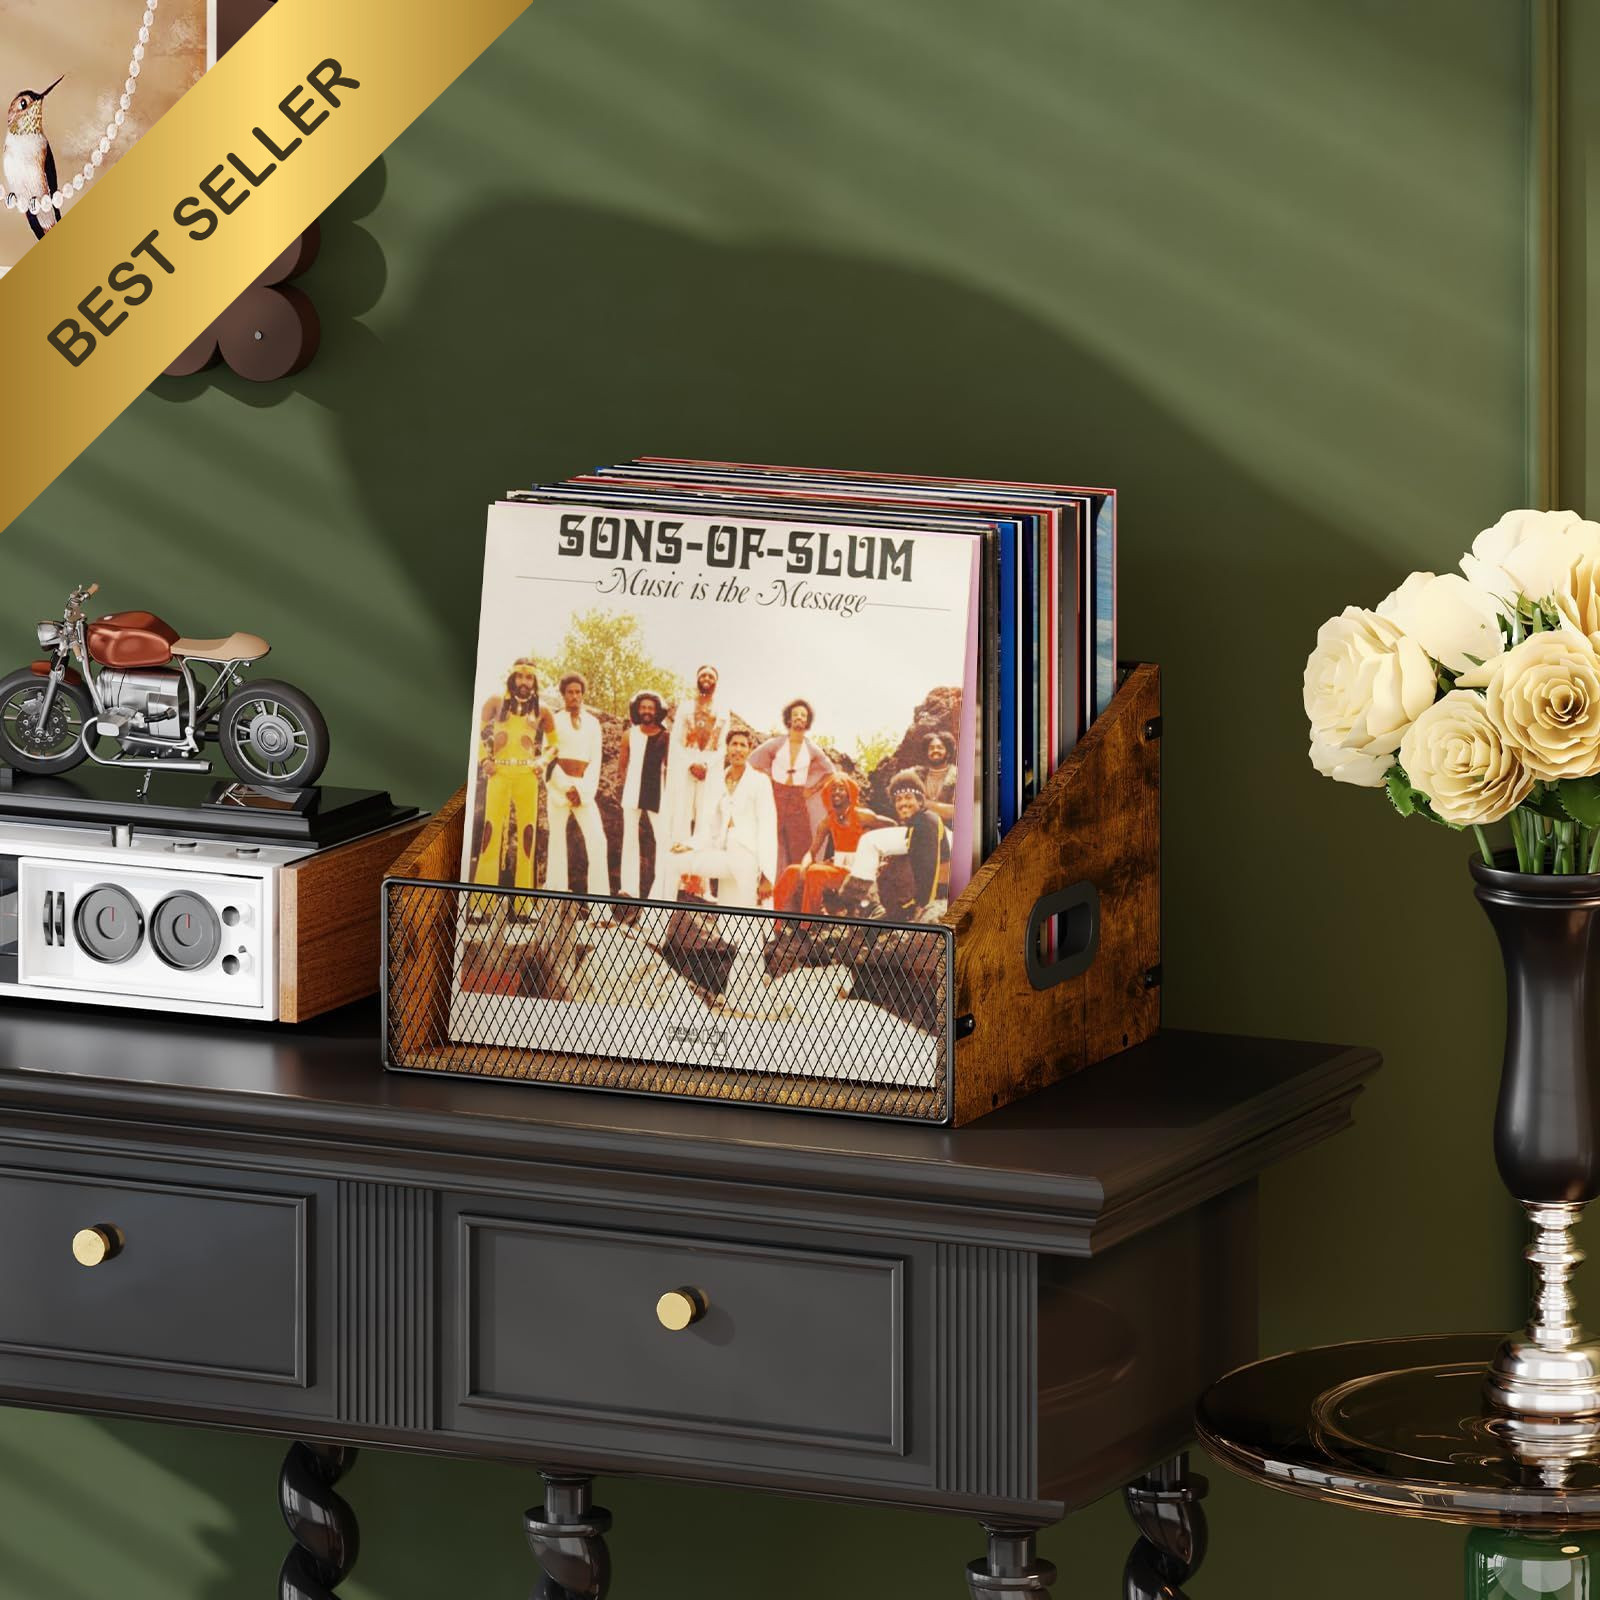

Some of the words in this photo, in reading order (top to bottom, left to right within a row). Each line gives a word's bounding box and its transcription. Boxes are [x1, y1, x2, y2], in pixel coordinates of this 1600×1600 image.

[558, 513, 915, 582] SONS-OF-SLUM
[596, 567, 684, 599] Music
[690, 573, 707, 601] is
[716, 576, 750, 604] the
[755, 580, 867, 618] Message
